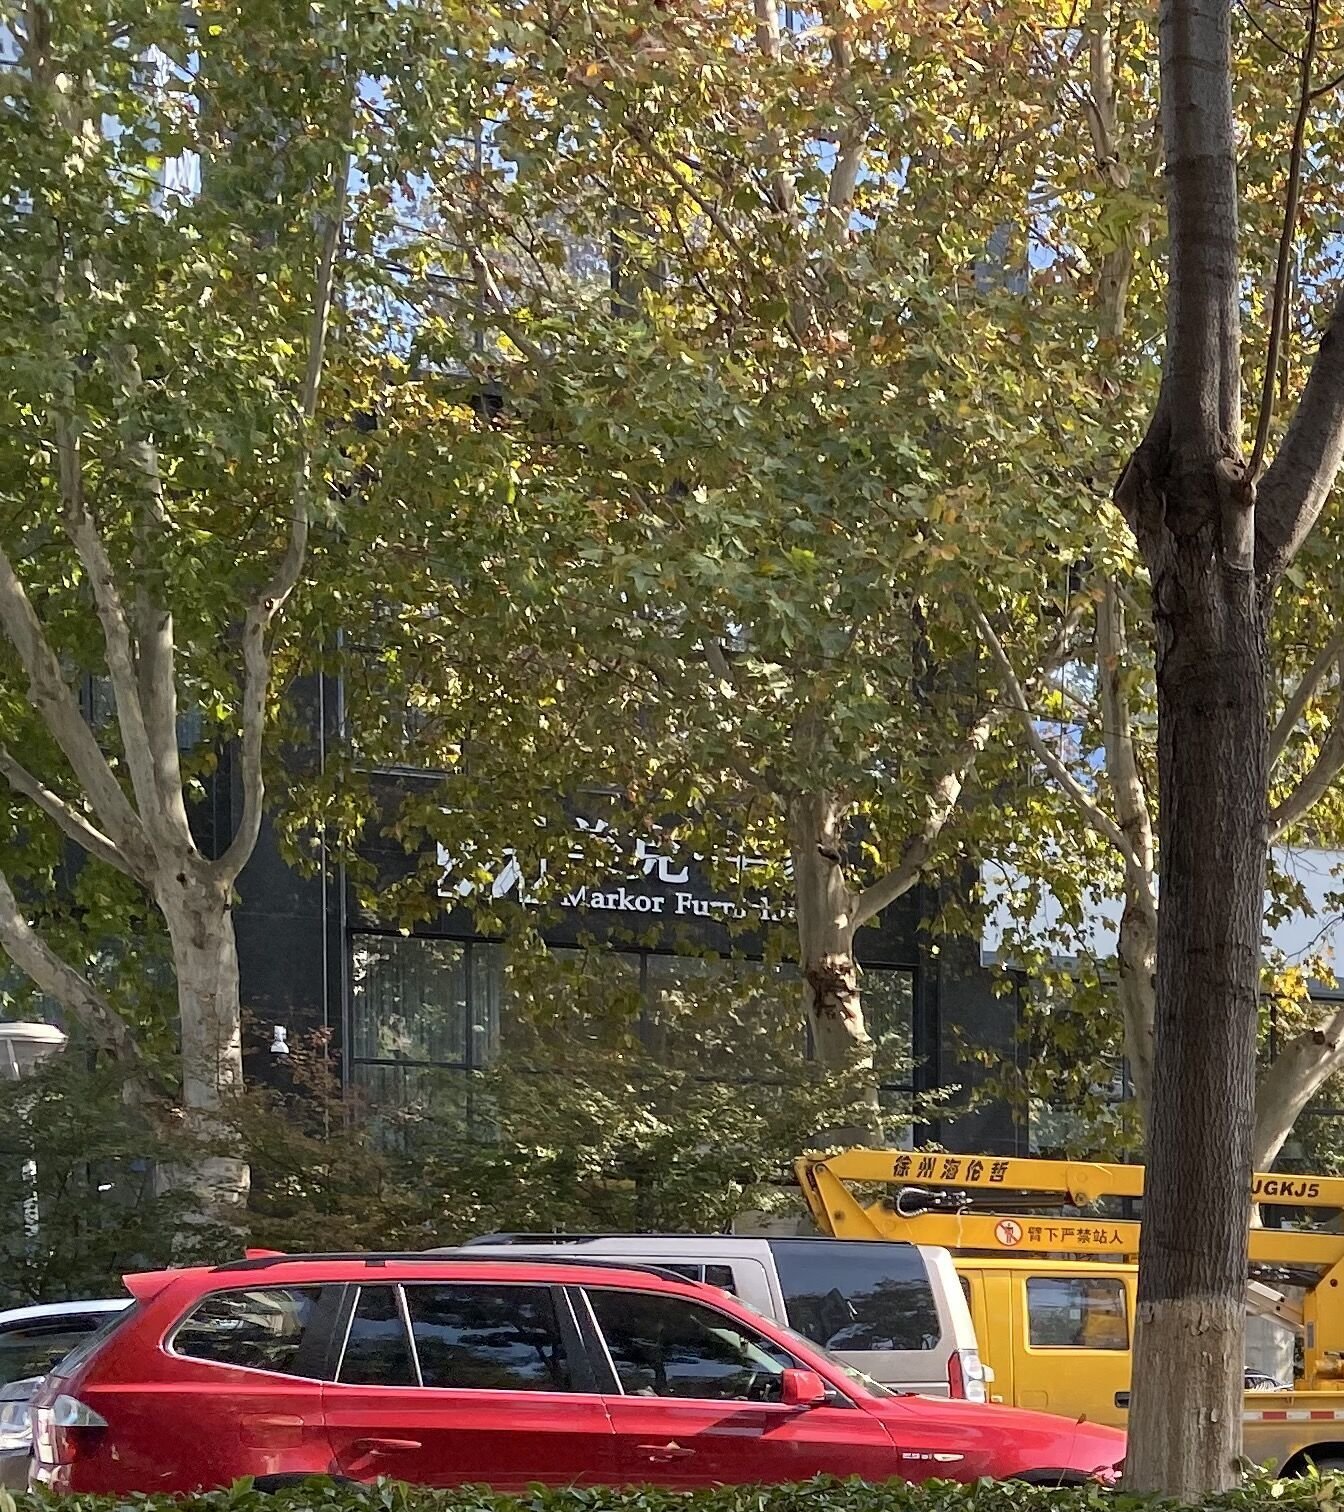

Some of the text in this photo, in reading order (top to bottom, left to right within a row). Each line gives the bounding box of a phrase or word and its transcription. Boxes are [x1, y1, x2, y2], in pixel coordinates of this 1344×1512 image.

[560, 885, 664, 913] Markor
[892, 1155, 1010, 1184] 徐州海伦哲
[1027, 1226, 1124, 1245] 臂下严禁站人
